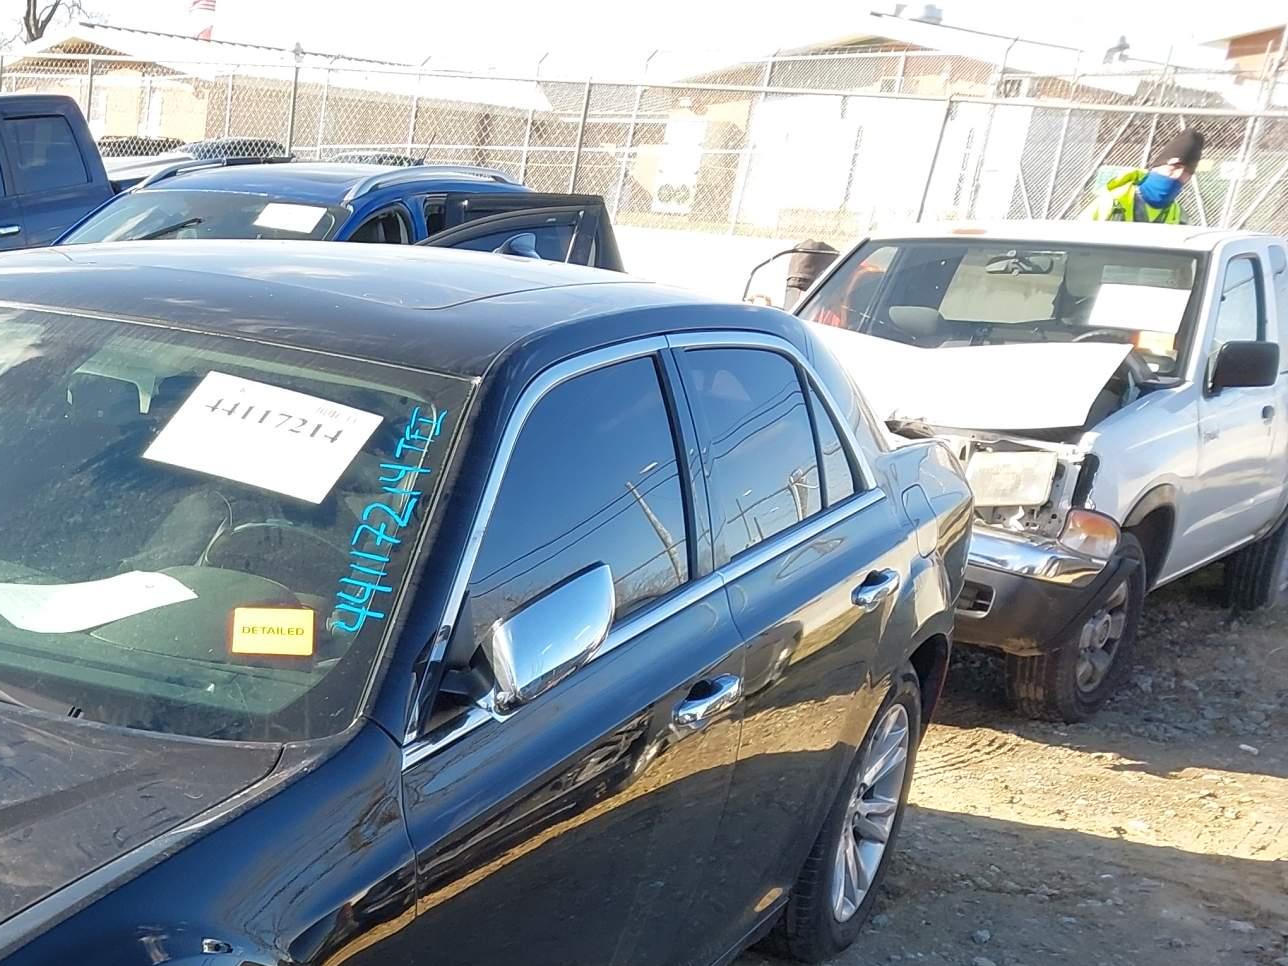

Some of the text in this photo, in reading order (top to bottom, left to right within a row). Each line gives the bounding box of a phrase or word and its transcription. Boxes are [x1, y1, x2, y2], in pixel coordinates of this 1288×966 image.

[205, 398, 344, 444] 44117214
[332, 462, 431, 632] 44117214
[242, 625, 305, 638] DETAILED
